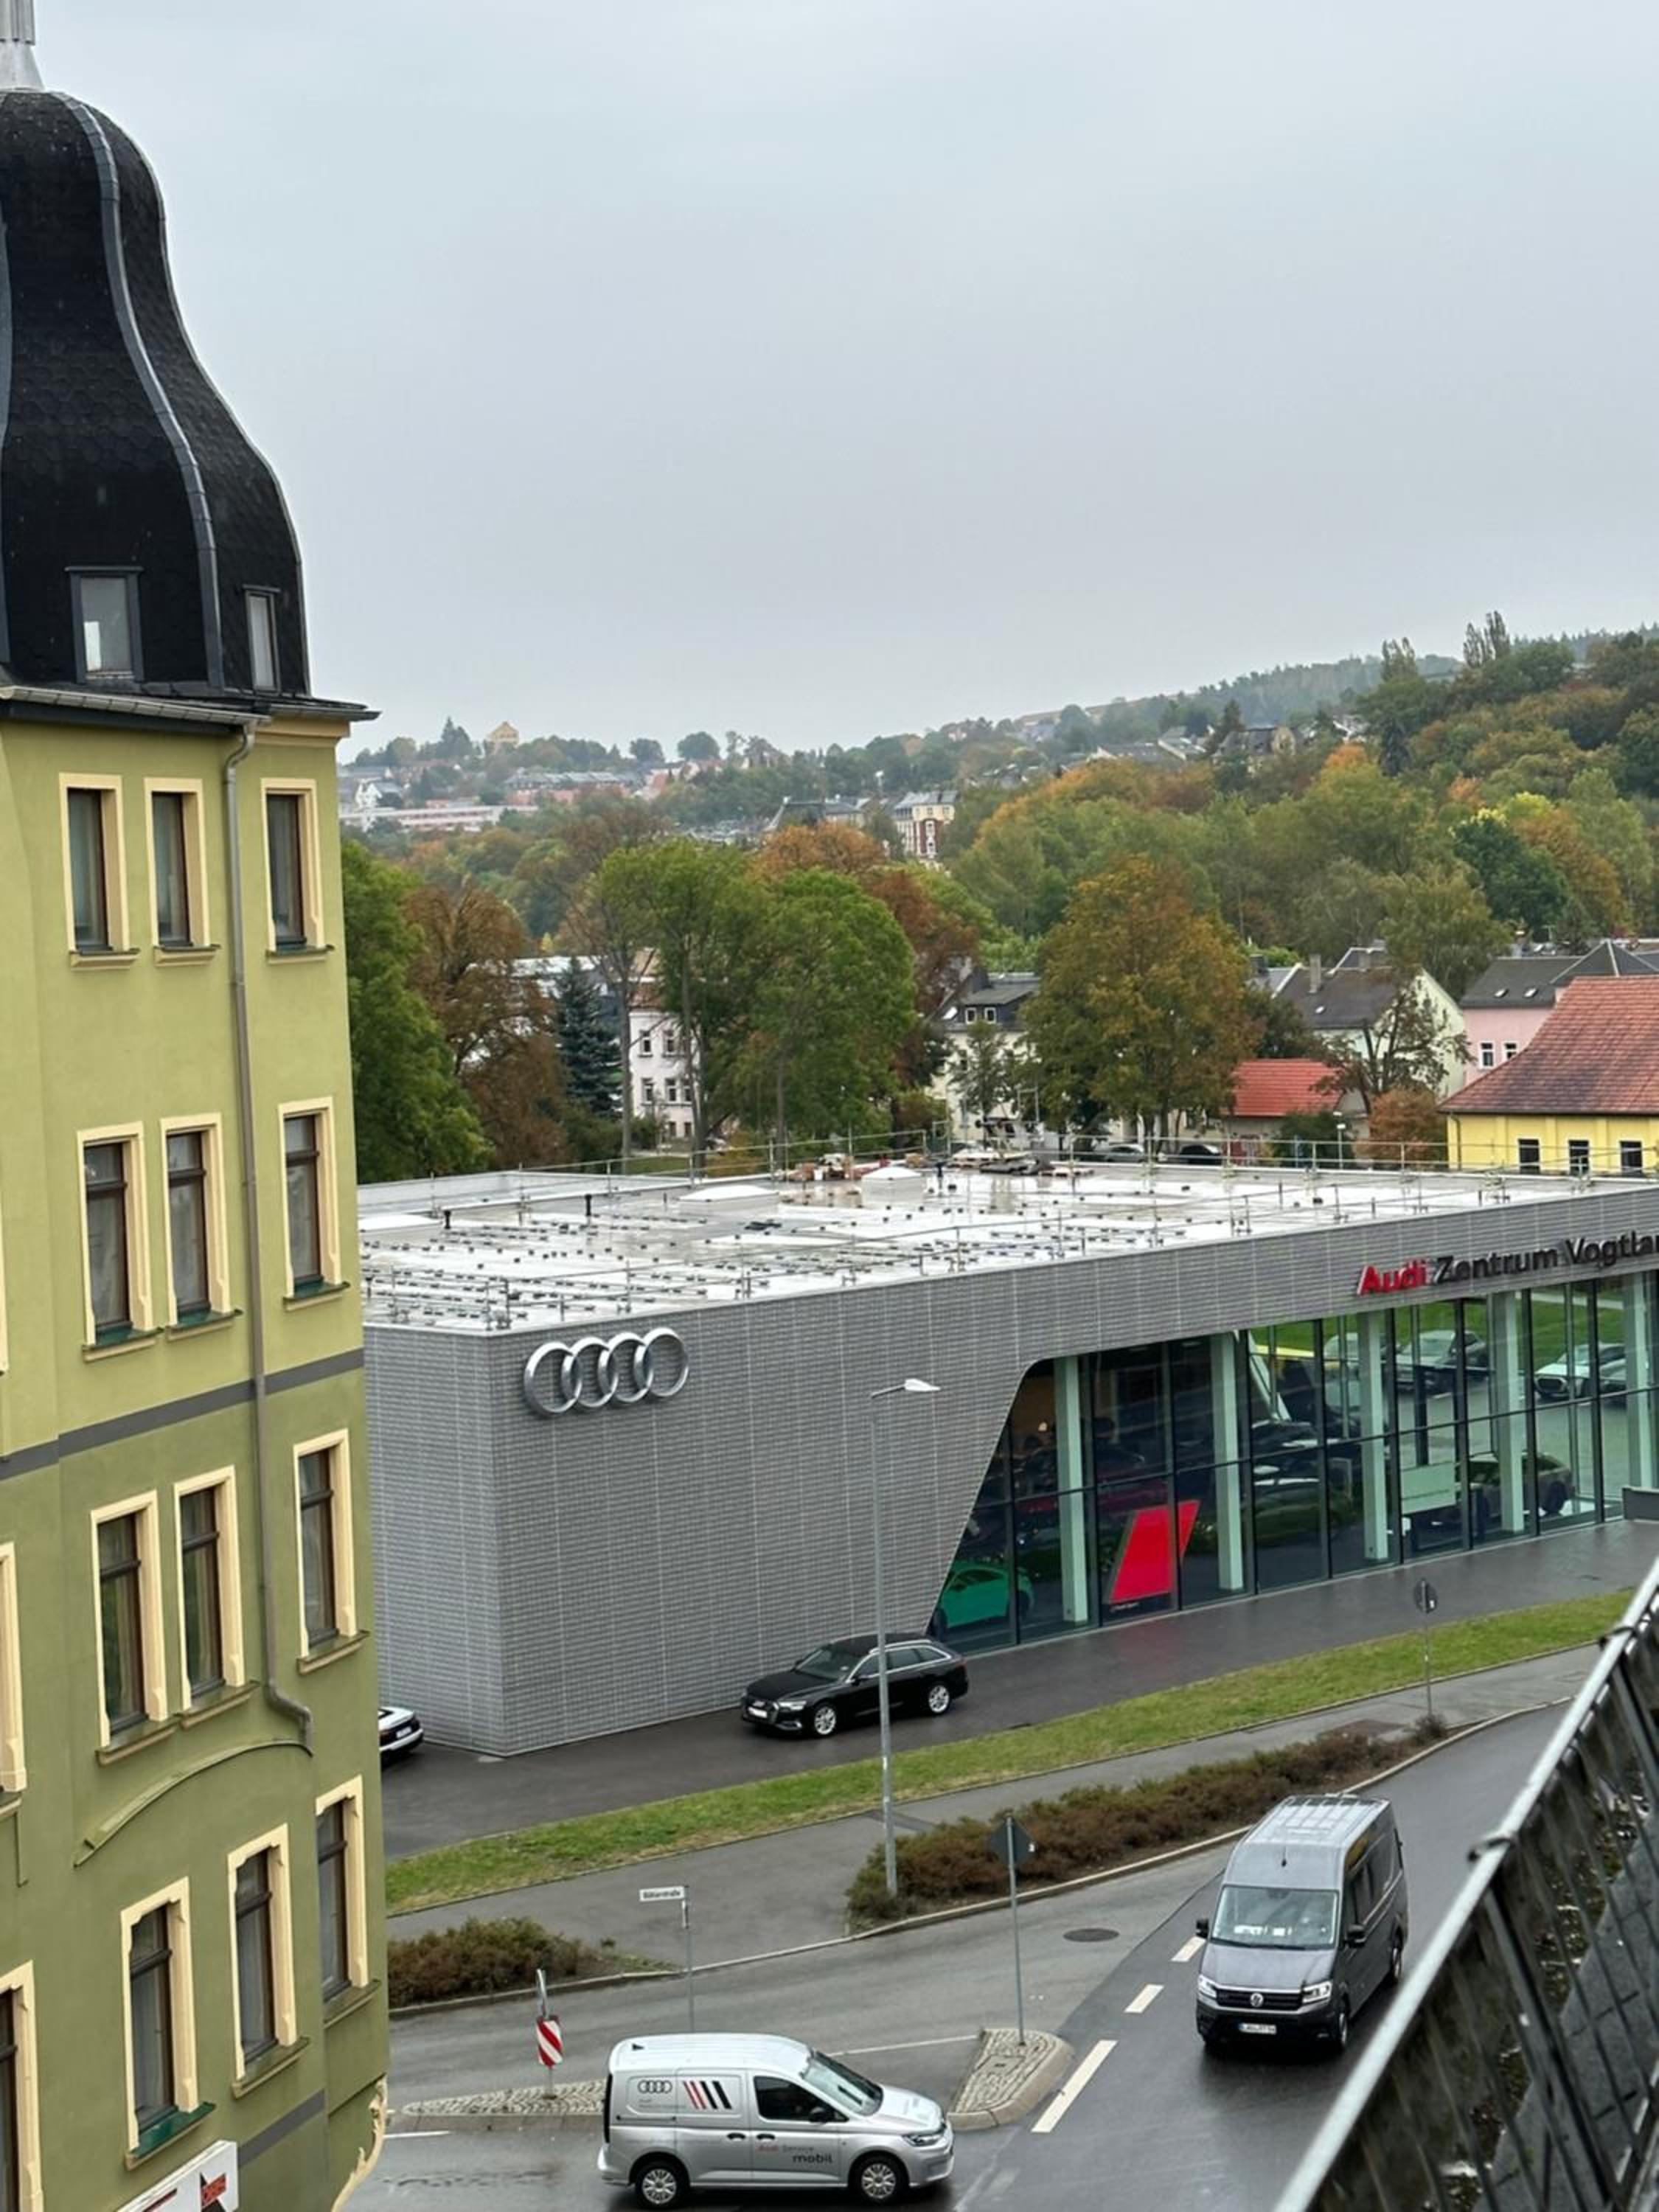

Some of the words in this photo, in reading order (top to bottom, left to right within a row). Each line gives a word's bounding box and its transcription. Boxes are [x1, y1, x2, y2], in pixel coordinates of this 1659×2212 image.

[1357, 1259, 1427, 1295] Audi
[1434, 1248, 1558, 1284] Zentrum
[1565, 1231, 1659, 1266] Vogtla
[793, 2154, 833, 2164] mobil
